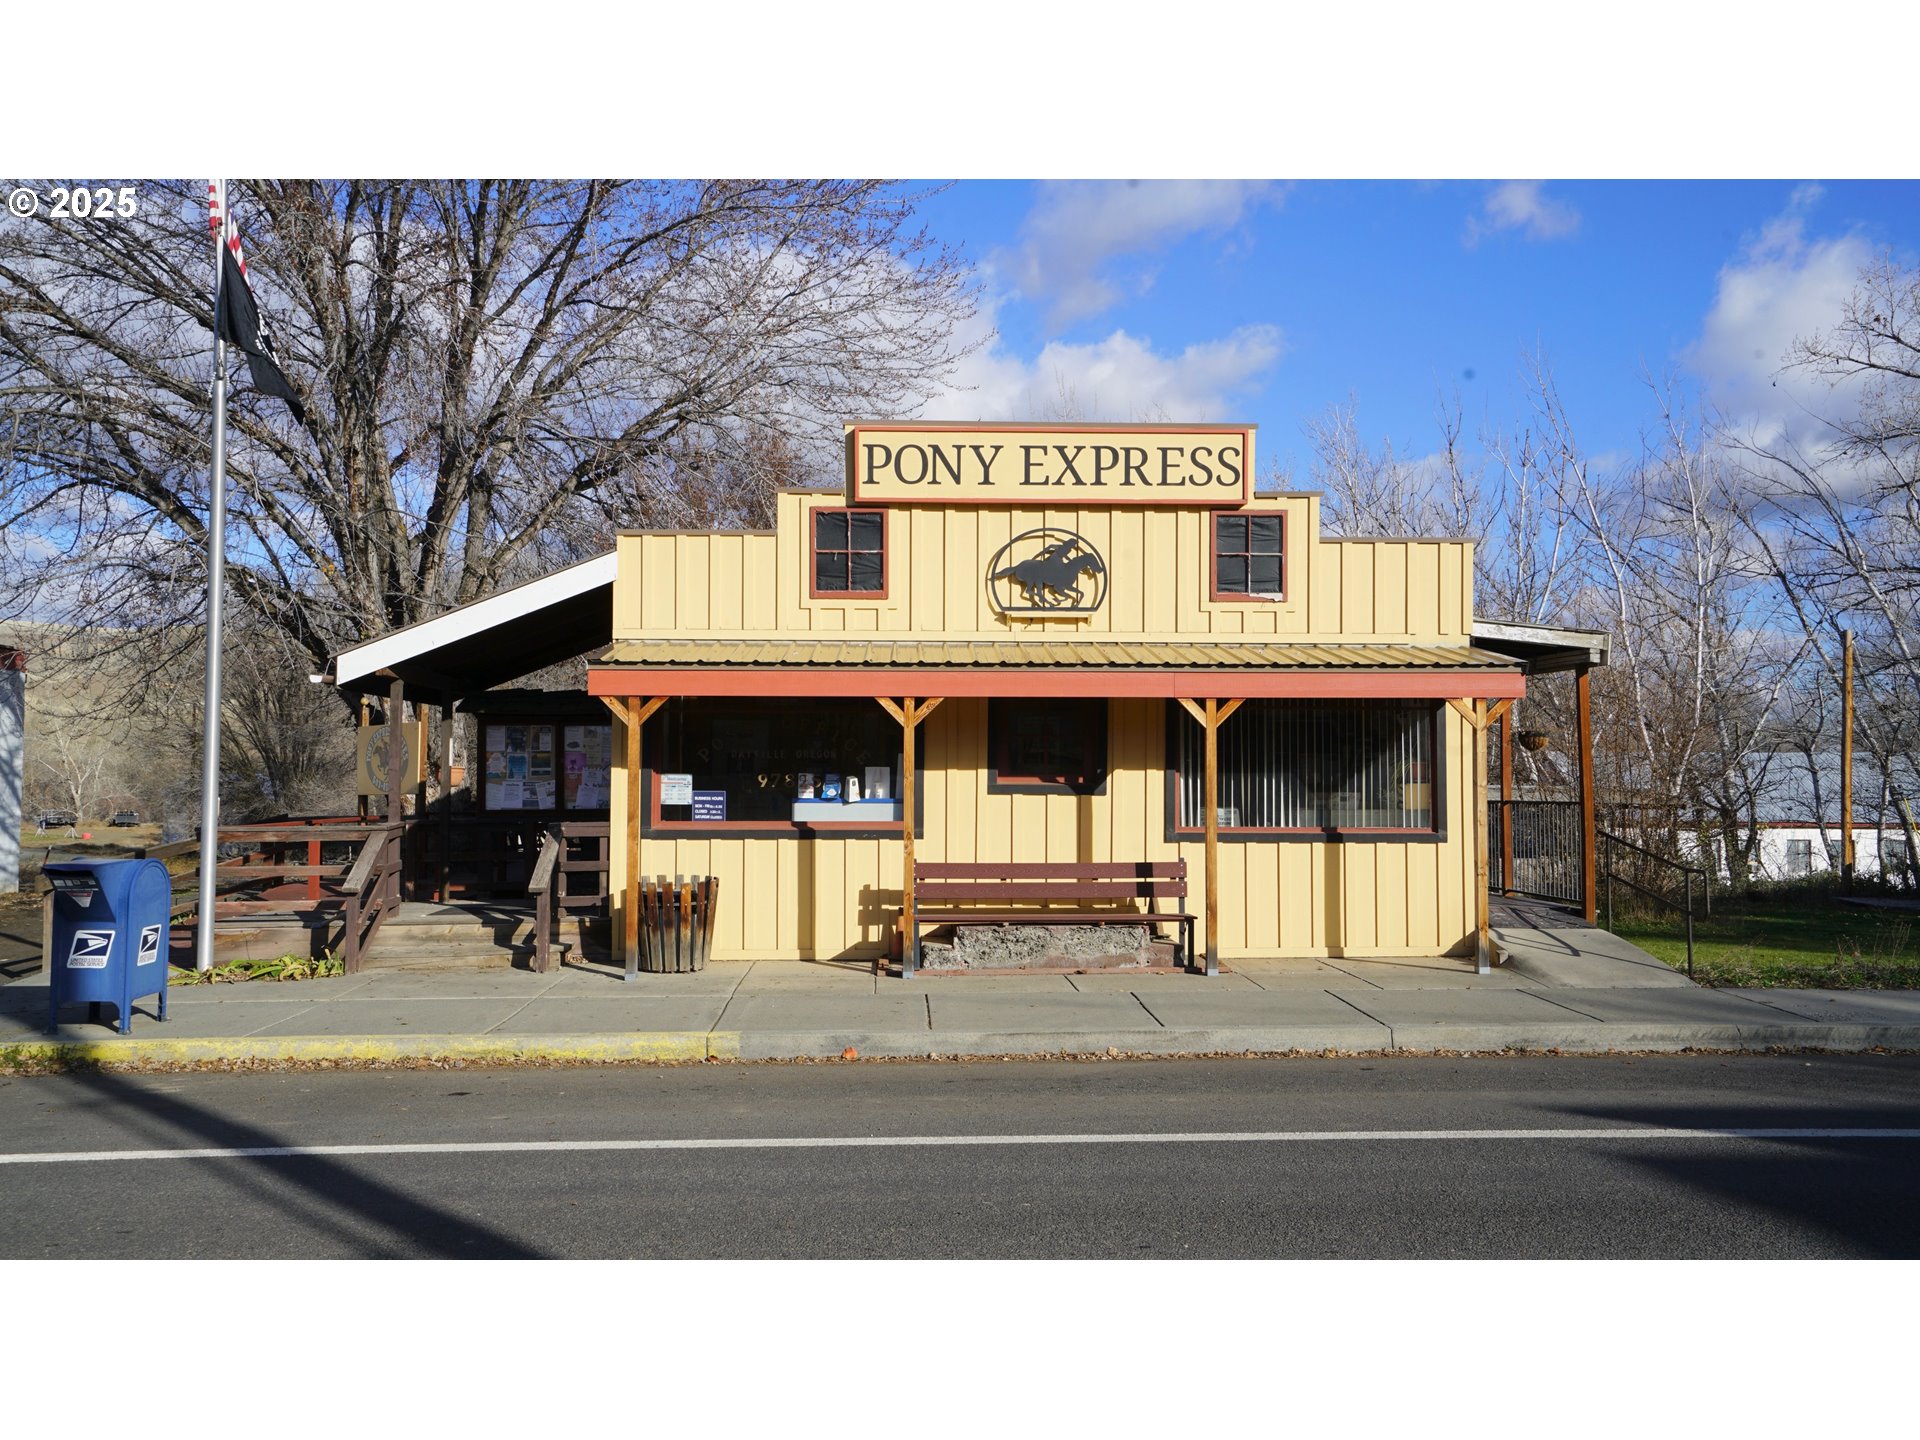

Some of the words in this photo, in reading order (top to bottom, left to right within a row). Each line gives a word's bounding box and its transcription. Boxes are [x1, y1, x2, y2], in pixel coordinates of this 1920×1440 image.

[861, 443, 1005, 486] PONY
[1019, 445, 1242, 487] EXPRESS
[795, 749, 838, 760] OREGON
